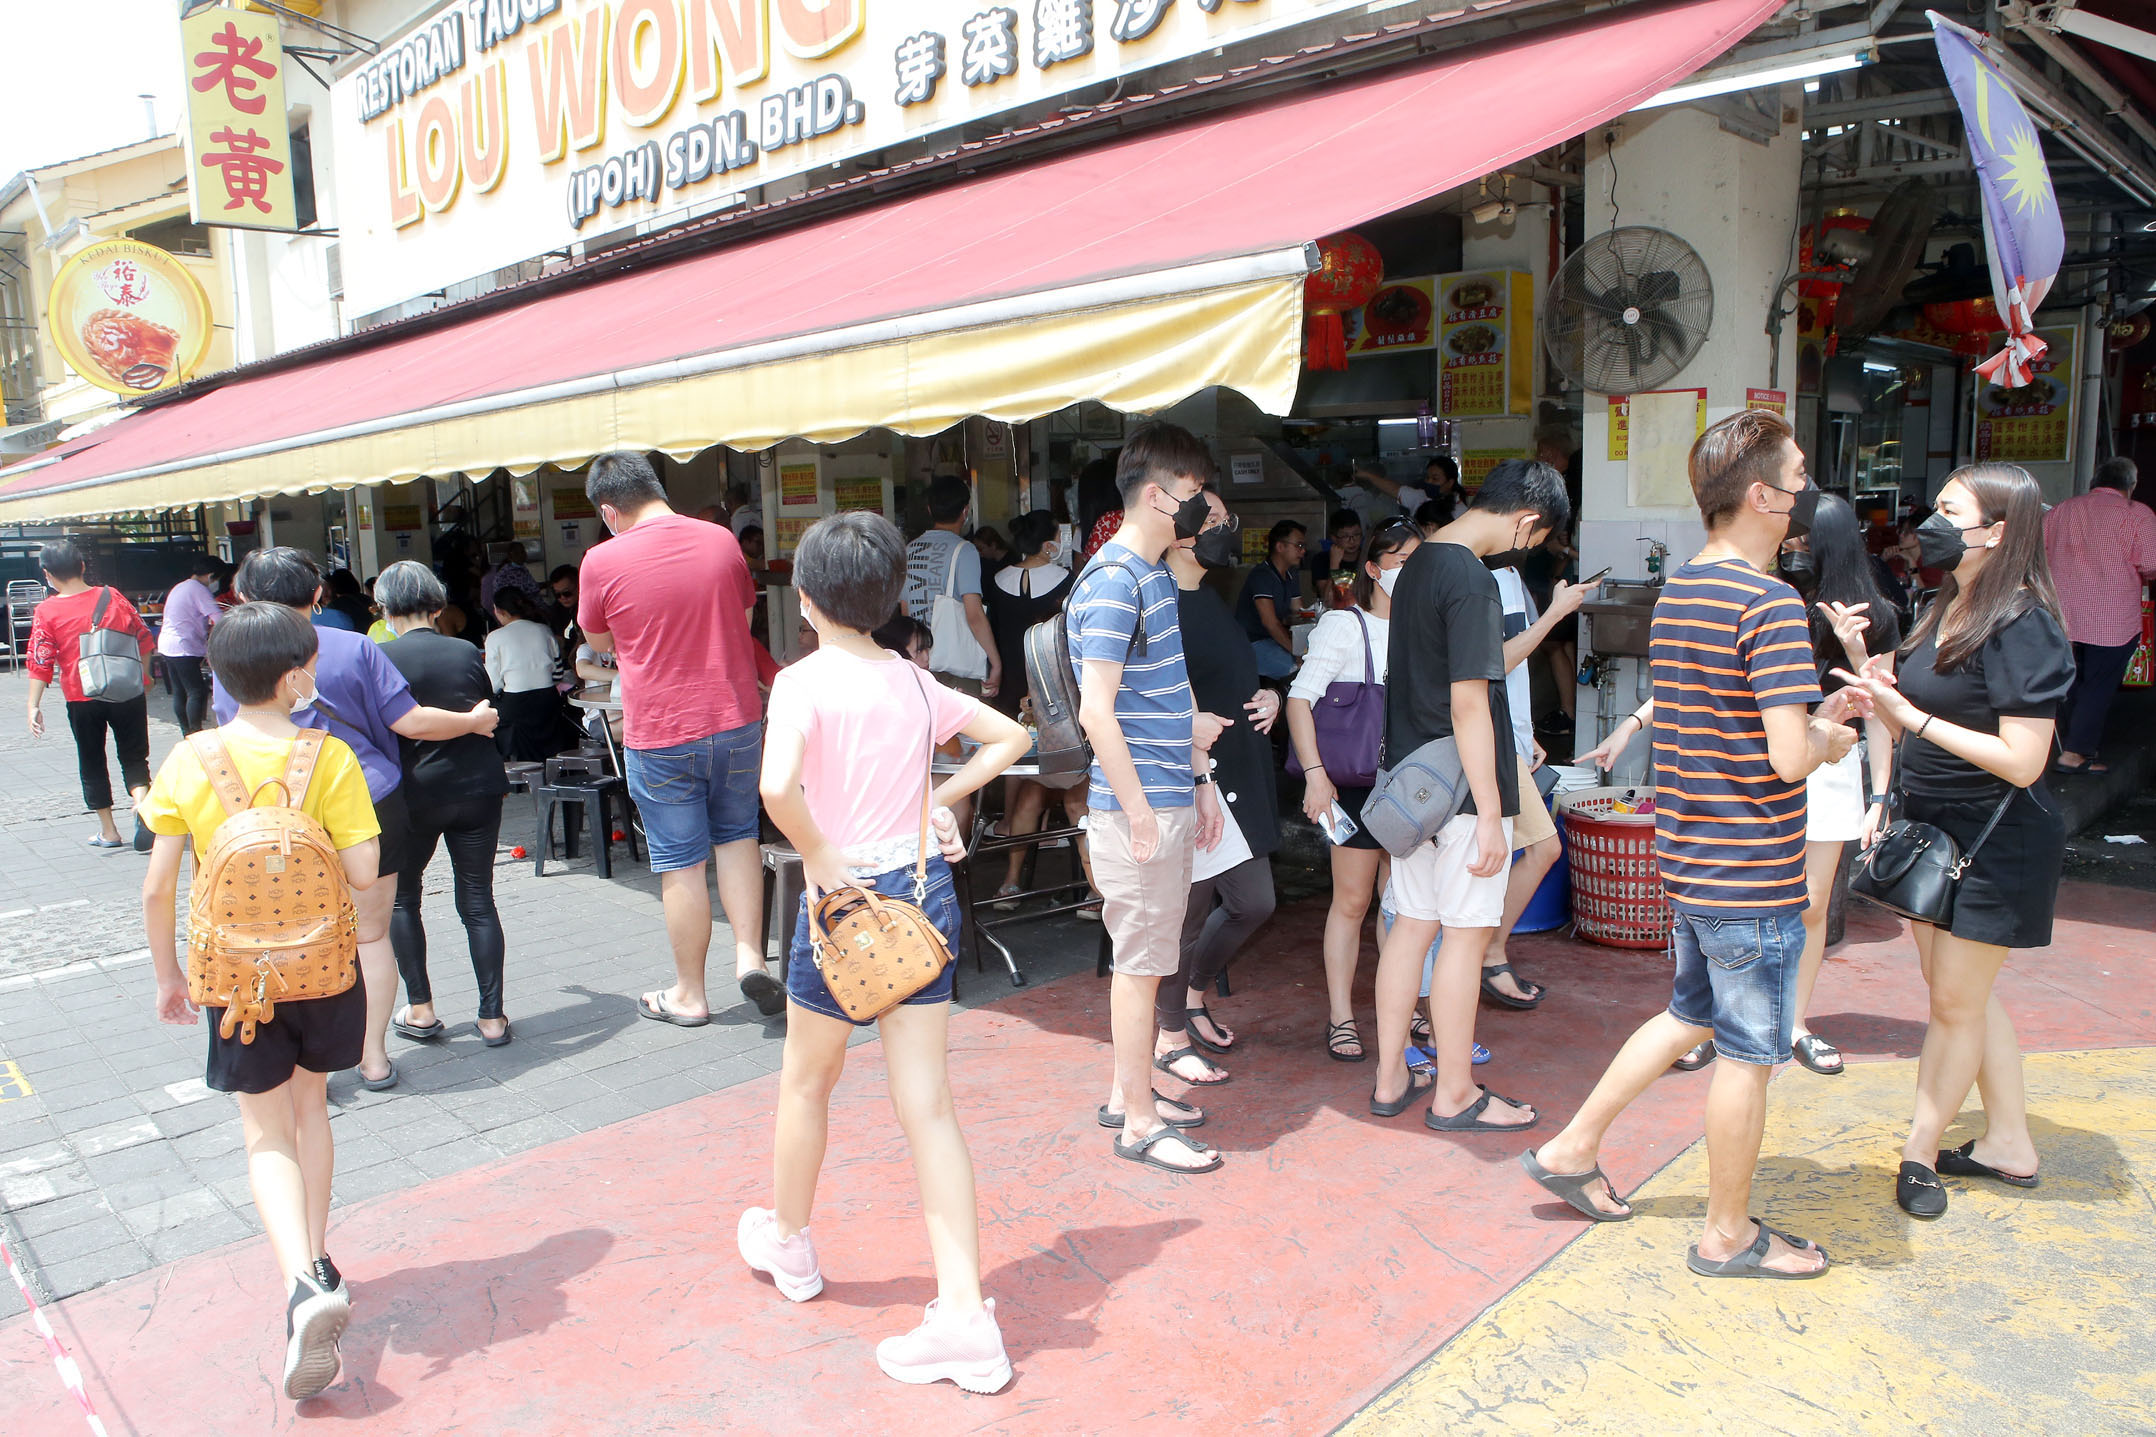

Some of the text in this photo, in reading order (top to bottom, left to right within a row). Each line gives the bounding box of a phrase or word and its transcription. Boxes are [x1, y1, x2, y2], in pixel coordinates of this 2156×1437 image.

[191, 22, 285, 214] 老黃
[357, 0, 563, 125] RESTORAN TAU
[385, 58, 509, 230] LOU
[567, 73, 866, 230] (IPOH) SDN. BHD.
[80, 244, 169, 265] KEDAI BISKUT
[927, 541, 948, 596] JEANS
